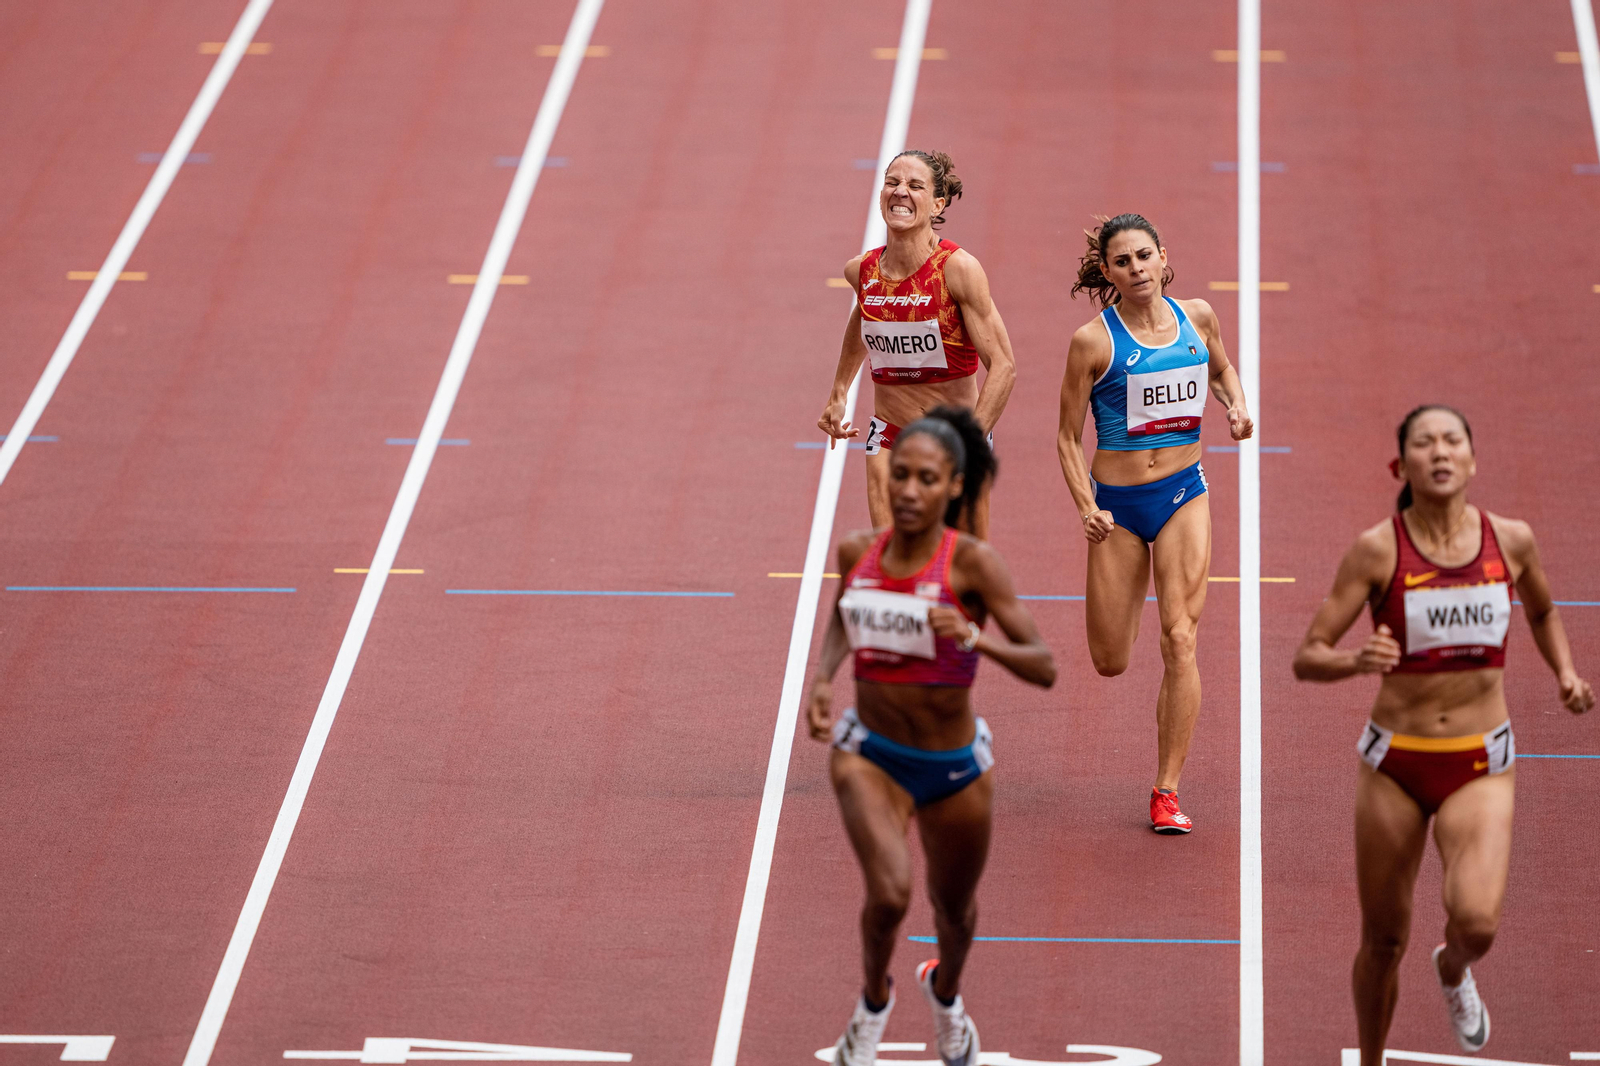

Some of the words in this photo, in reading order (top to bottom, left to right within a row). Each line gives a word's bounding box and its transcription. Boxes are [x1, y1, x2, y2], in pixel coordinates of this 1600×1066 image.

[863, 294, 933, 307] ESPAÑA
[864, 333, 937, 354] ROMERO
[1143, 381, 1197, 406] BELLO
[1427, 603, 1494, 629] WANG
[1364, 724, 1382, 757] 7
[1493, 727, 1510, 767] 7
[283, 1037, 633, 1064] 4
